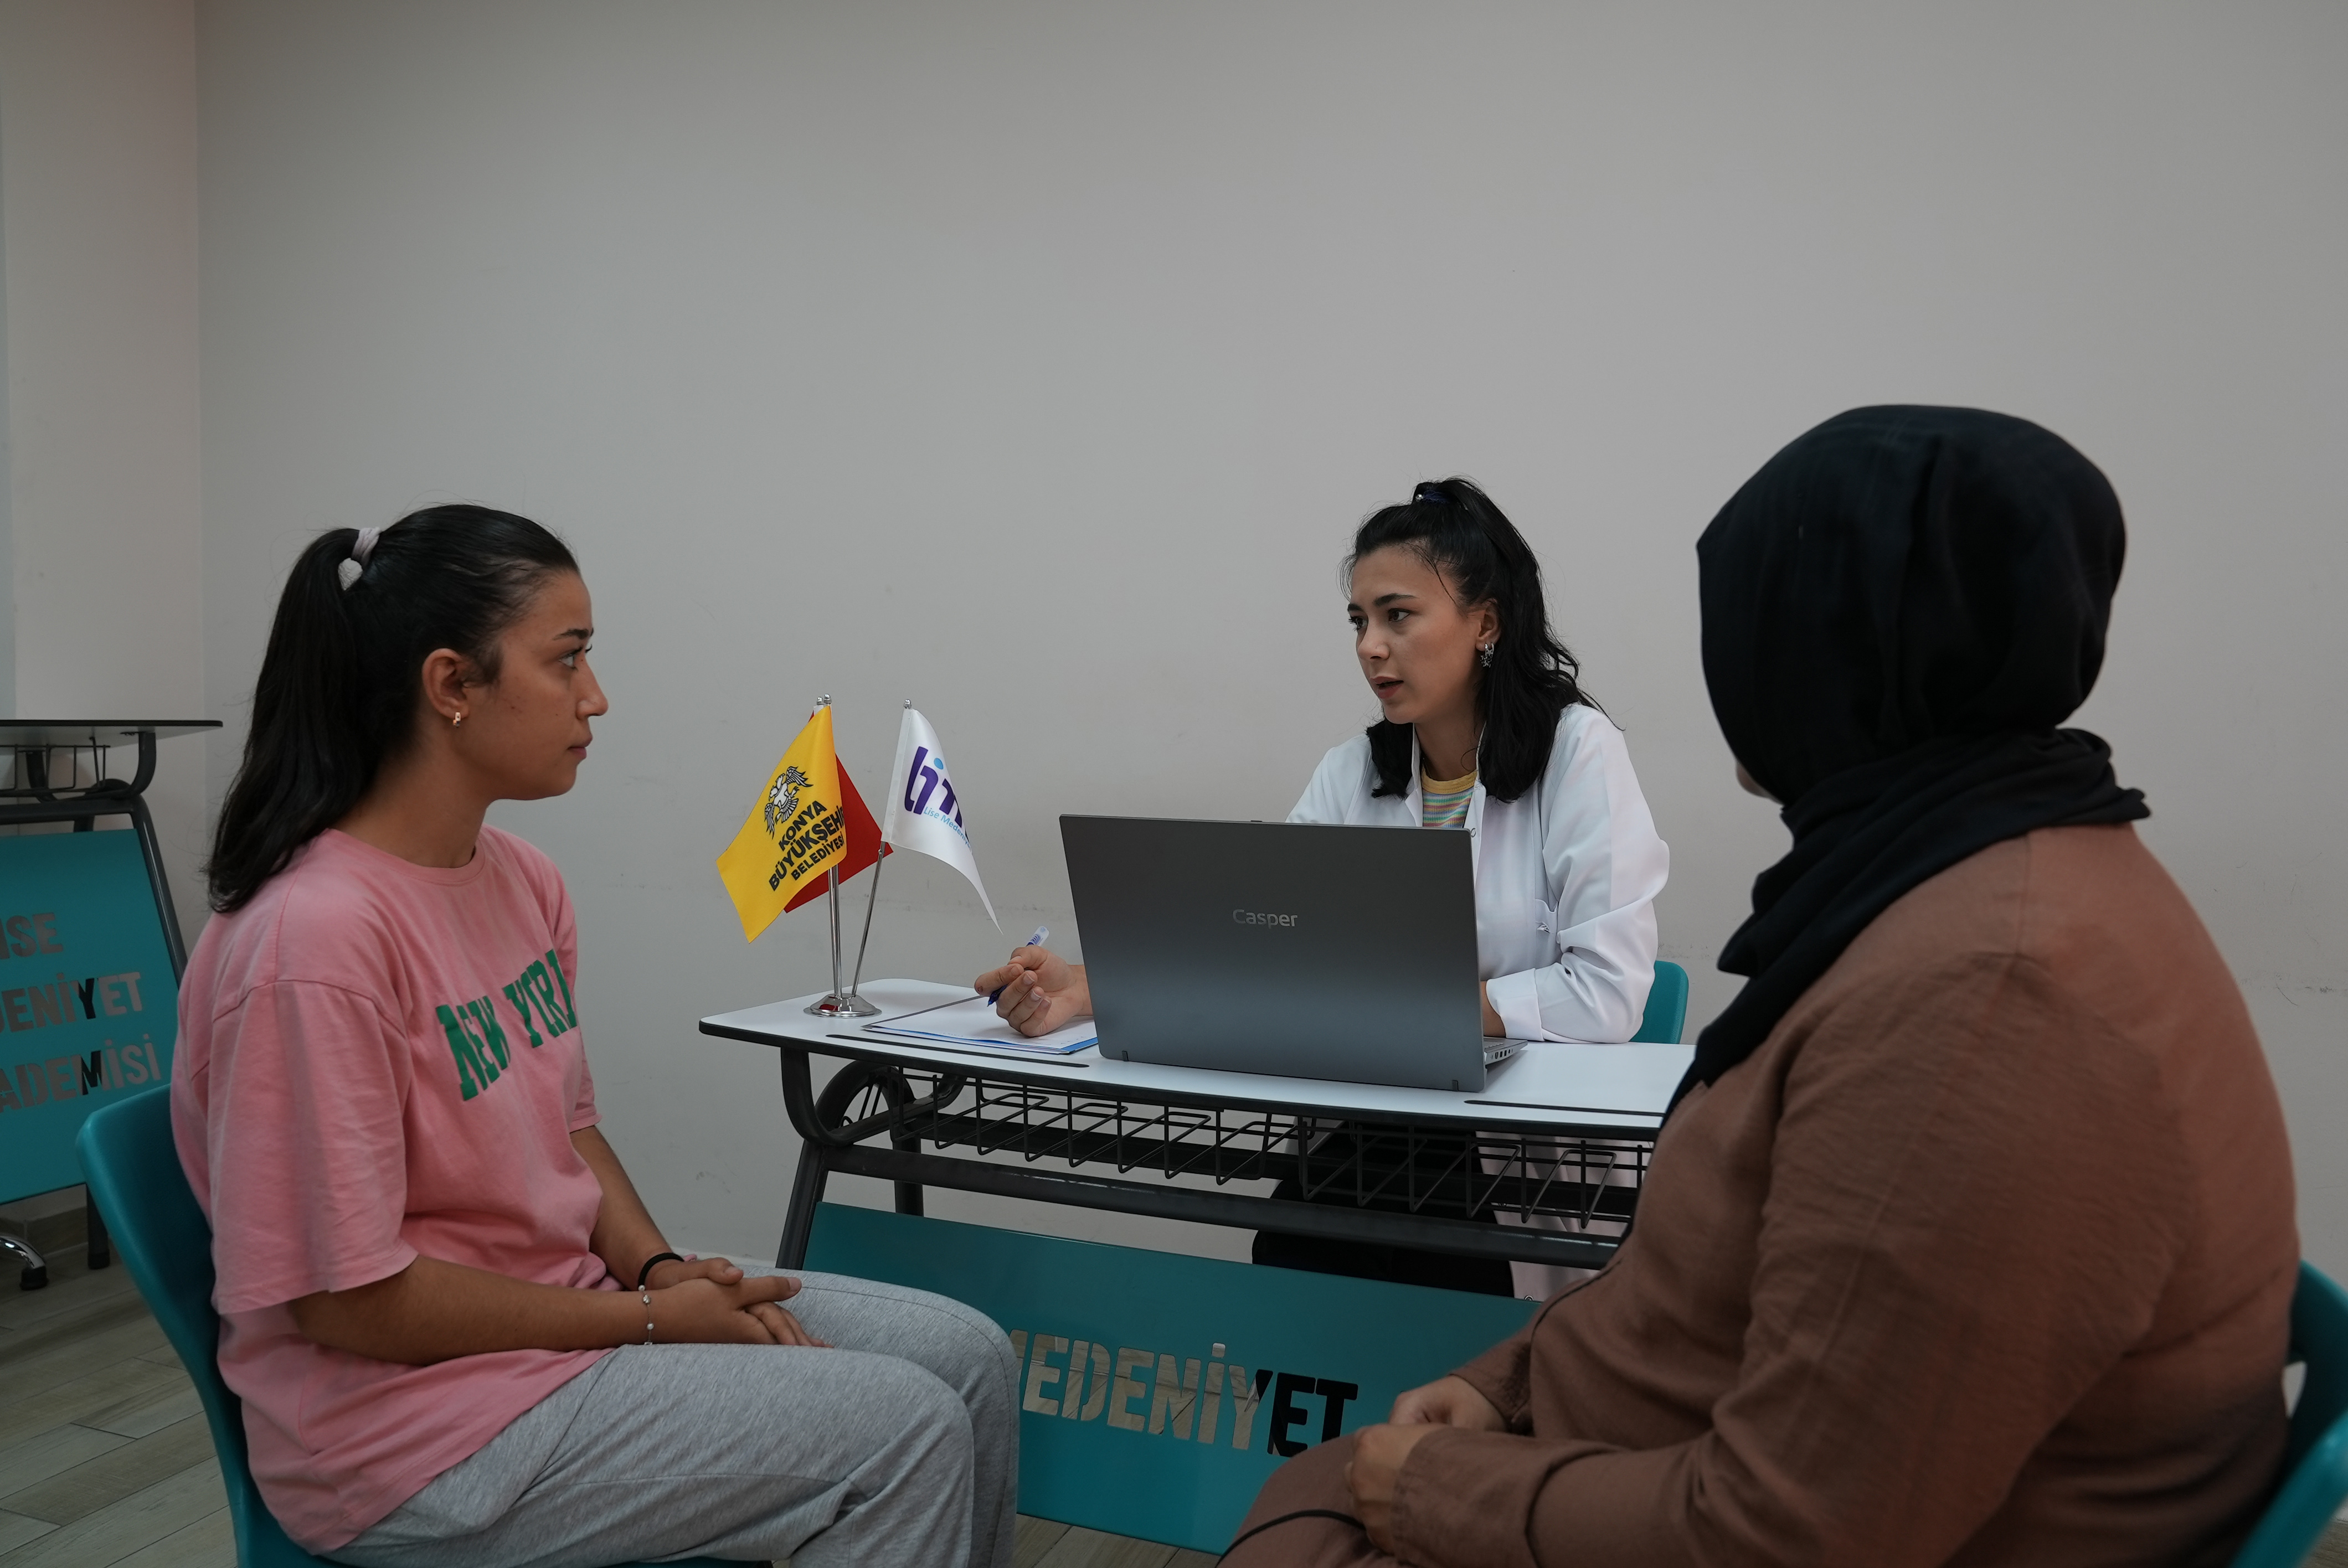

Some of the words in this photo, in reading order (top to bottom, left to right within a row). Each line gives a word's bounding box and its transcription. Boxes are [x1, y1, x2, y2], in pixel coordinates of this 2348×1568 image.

[779, 801, 827, 852] KONYA
[924, 807, 939, 818] Lise
[791, 831, 845, 881] BELEDİYESİ
[1233, 909, 1298, 930] Casper
[0, 972, 143, 1034] ENİYET
[435, 996, 511, 1101] NEW
